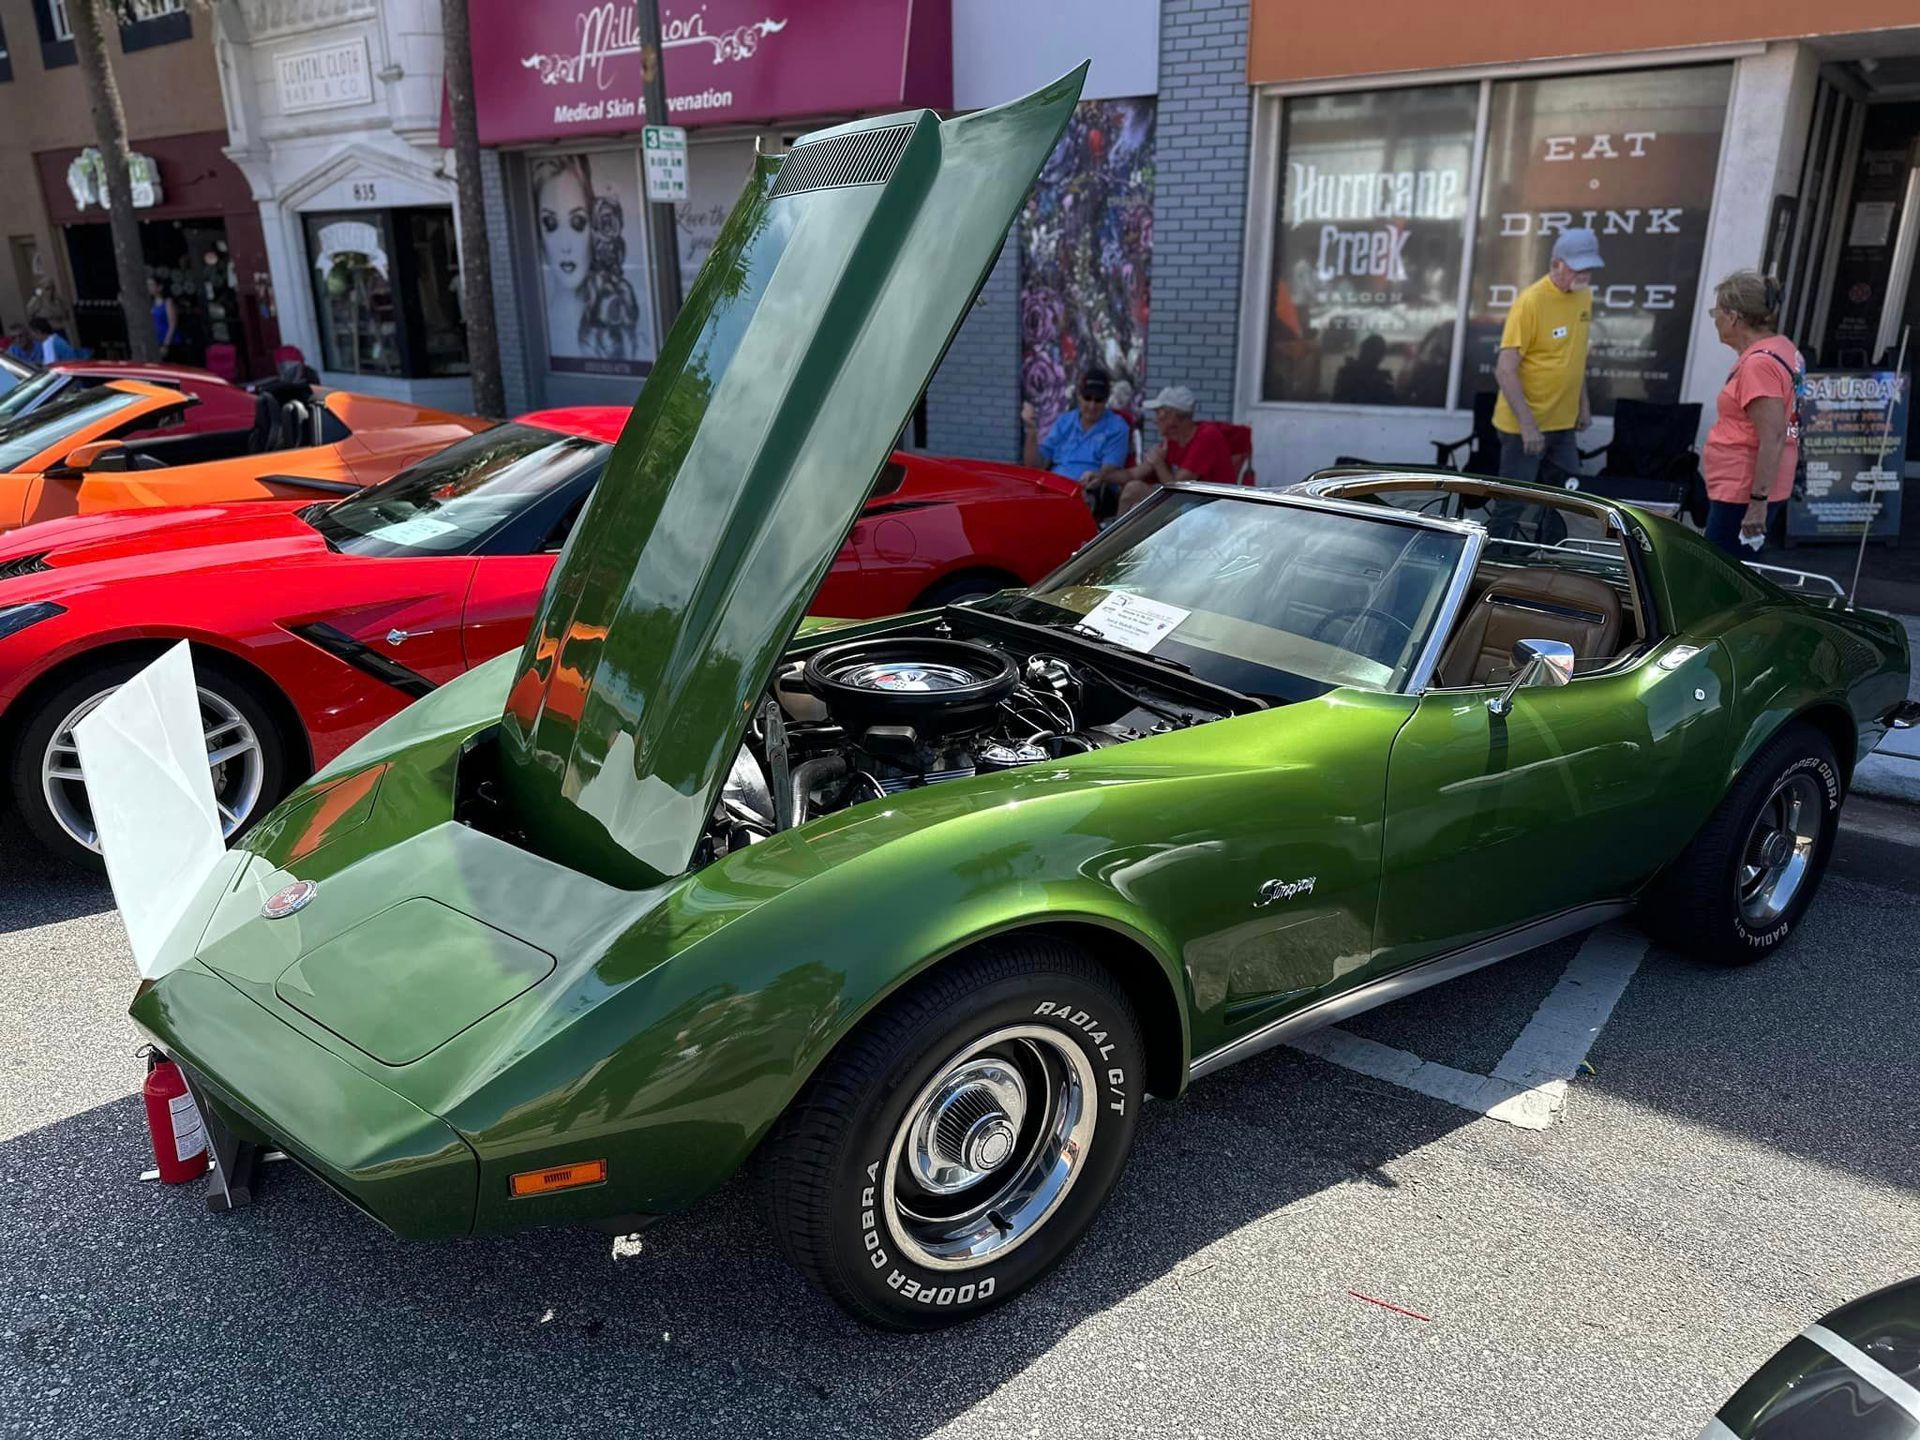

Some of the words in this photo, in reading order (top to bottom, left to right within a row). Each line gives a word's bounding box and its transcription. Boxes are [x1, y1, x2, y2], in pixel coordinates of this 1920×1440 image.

[554, 102, 603, 123] Medical
[606, 97, 634, 119] Skin
[637, 88, 732, 117] Rvenation
[648, 131, 658, 148] 3
[1544, 131, 1657, 162] EAT
[353, 183, 376, 201] 835
[1290, 162, 1458, 231] Hurricane
[1500, 208, 1683, 236] DRINK
[1316, 224, 1412, 282] Creek
[1317, 292, 1404, 303] SALOON
[1488, 284, 1677, 309] DCE
[1803, 378, 1904, 400] SATURDAY
[1818, 762, 1838, 811] COBRA
[1252, 876, 1317, 908] Stingray
[1747, 921, 1789, 947] RADIAL
[1033, 1001, 1116, 1061] RADIAL
[1107, 1067, 1126, 1118] G/T
[861, 1160, 888, 1269] COBRA
[886, 1268, 996, 1306] COOPER
